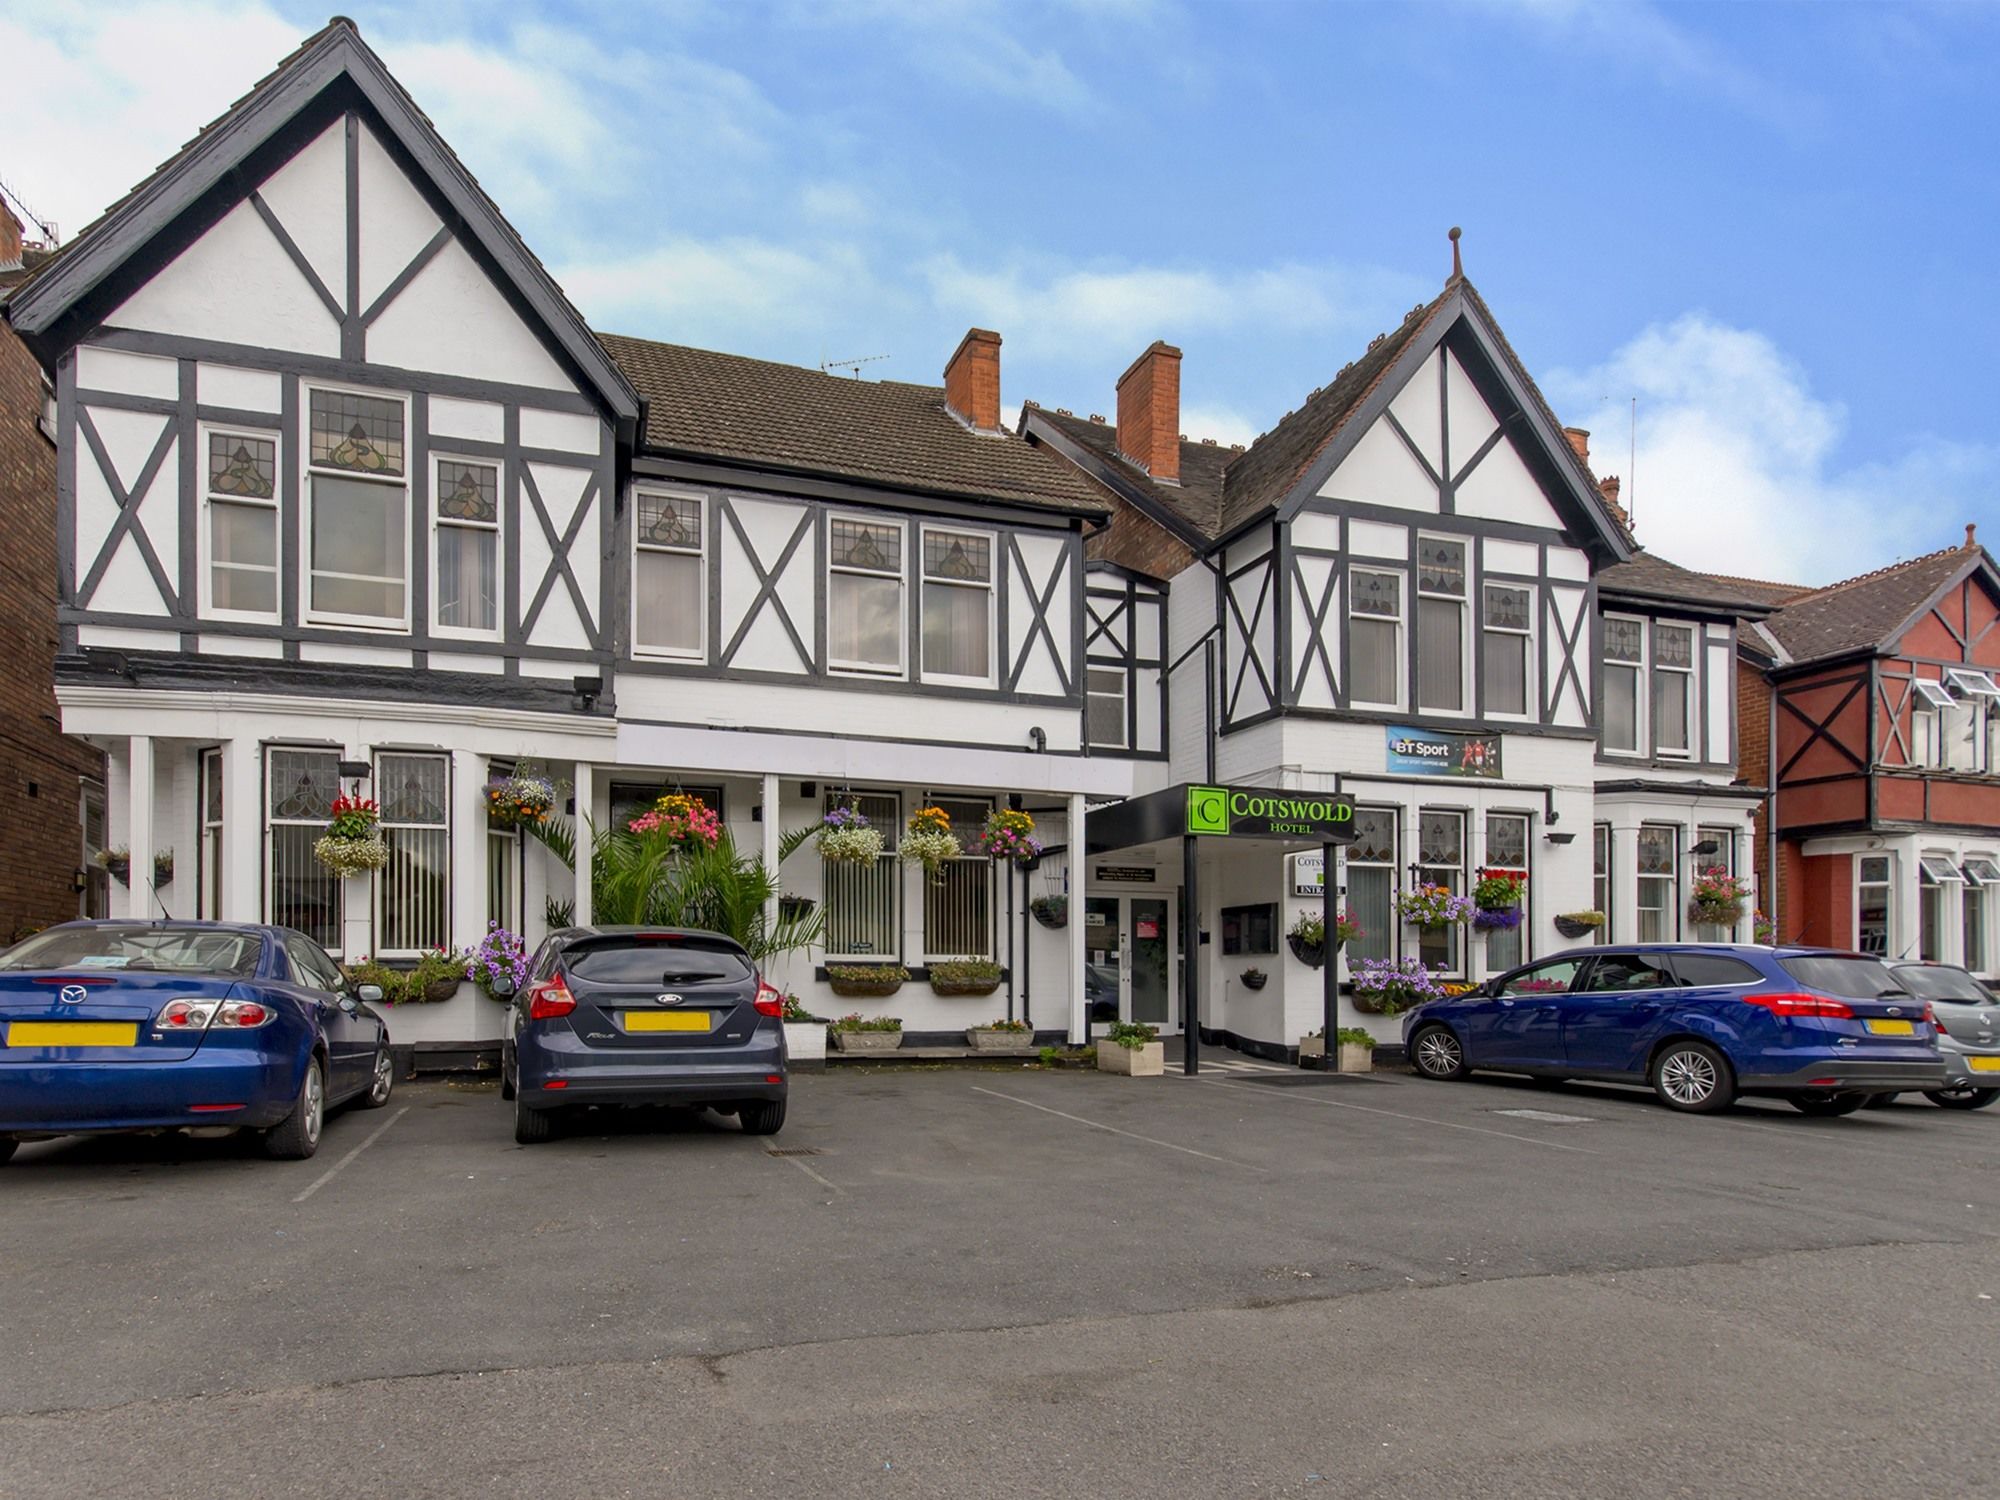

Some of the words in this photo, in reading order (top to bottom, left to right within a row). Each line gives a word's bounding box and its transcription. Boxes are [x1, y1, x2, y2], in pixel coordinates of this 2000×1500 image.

[1396, 742, 1415, 754] BT
[1416, 742, 1449, 757] Sport
[1198, 798, 1221, 824] C
[1230, 792, 1351, 822] COTSWOLD
[1270, 823, 1314, 834] HOTEL
[1297, 857, 1345, 867] COTSD
